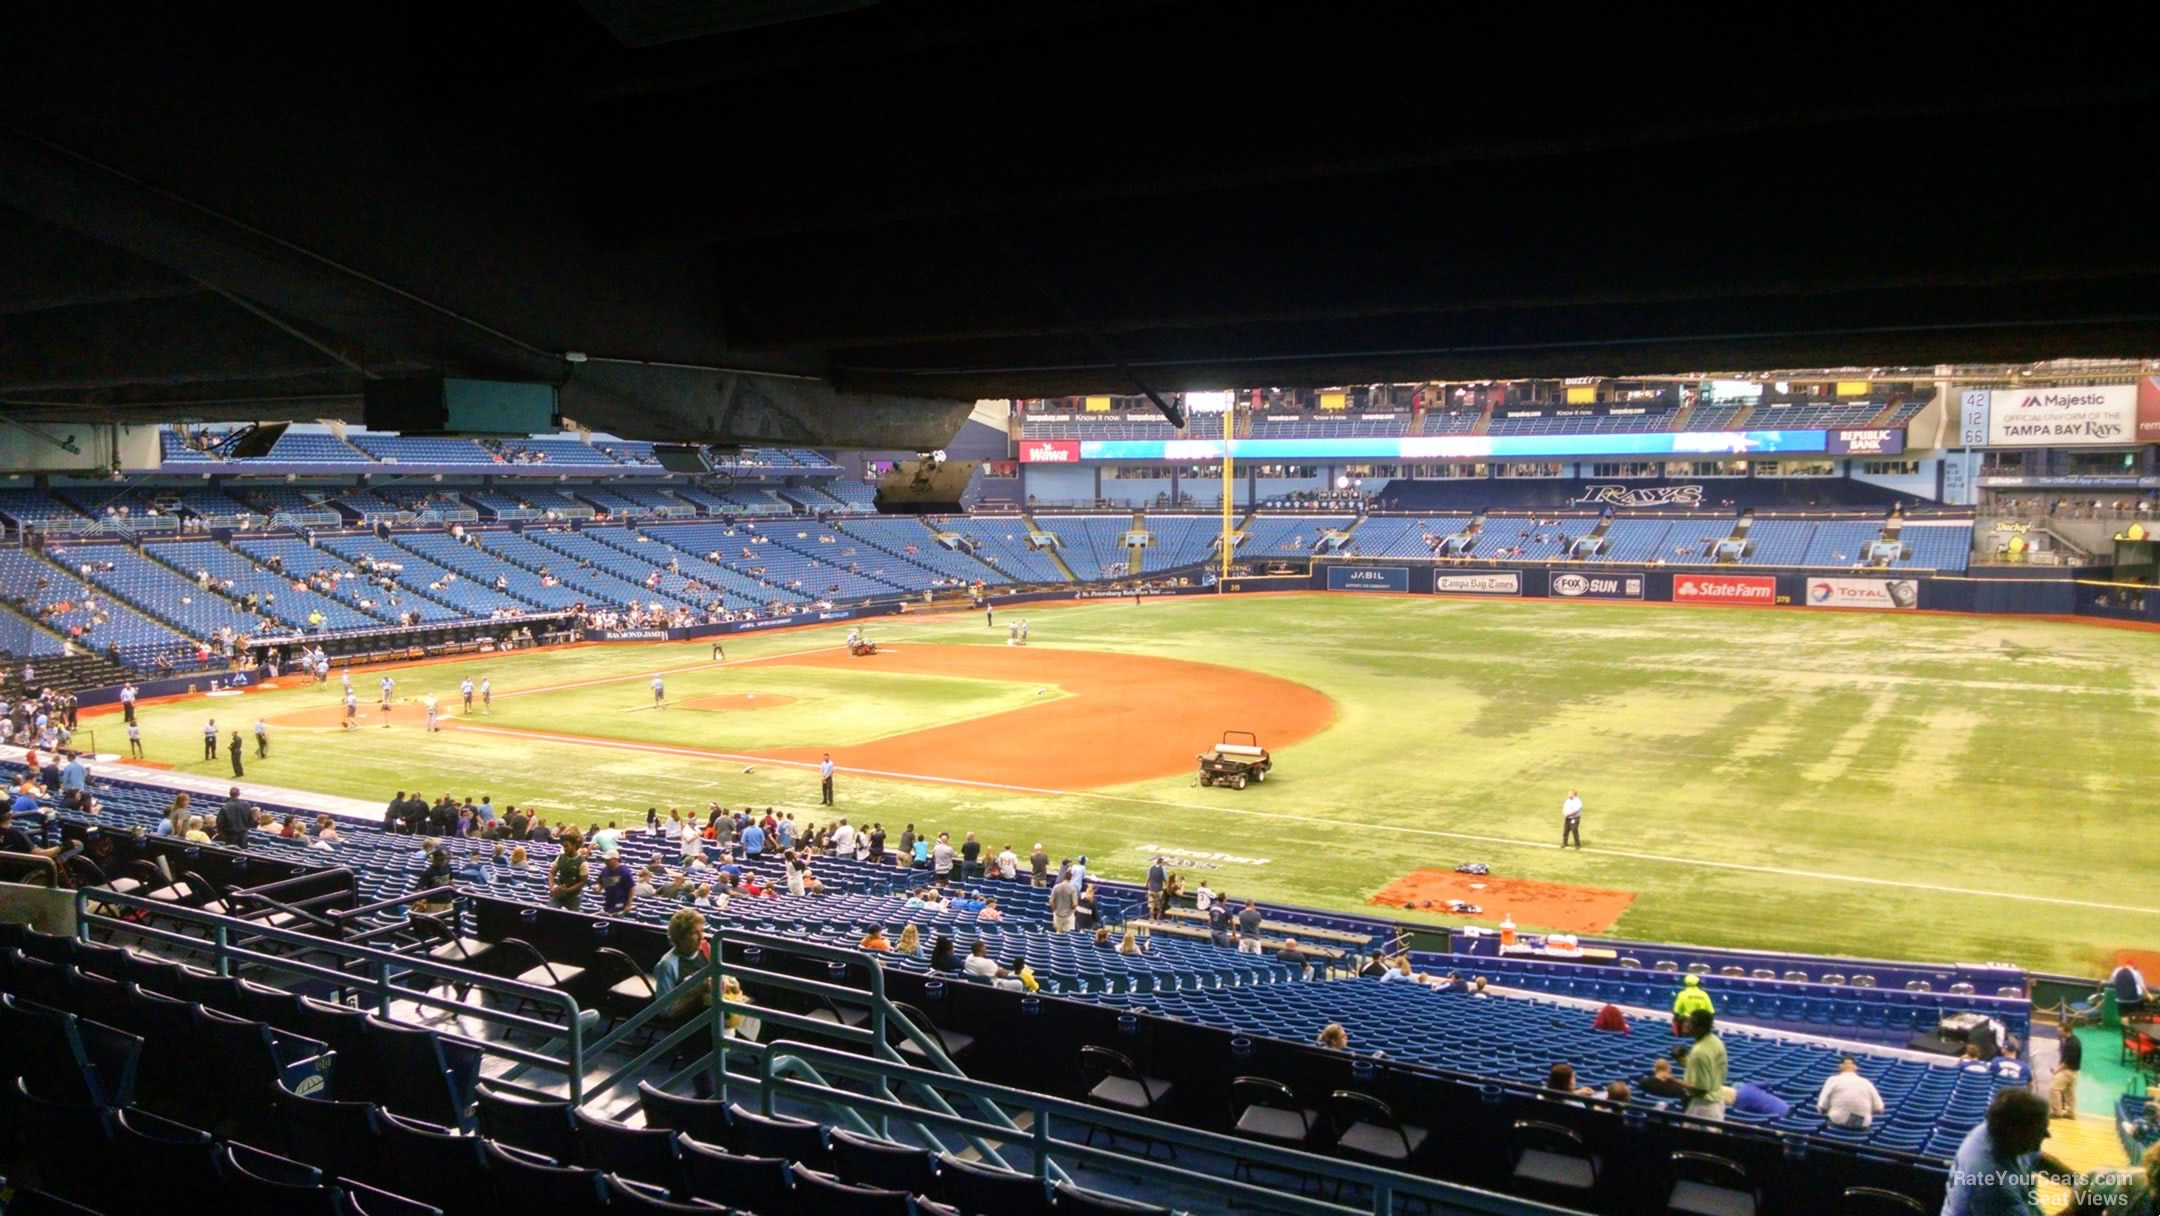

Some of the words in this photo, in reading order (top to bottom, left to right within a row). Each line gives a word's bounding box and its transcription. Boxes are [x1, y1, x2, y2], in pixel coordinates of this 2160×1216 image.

[1966, 393, 1985, 406] 42
[2044, 393, 2105, 409] Majestic
[1075, 414, 1096, 422] Know
[1967, 411, 1982, 425] 12
[2003, 414, 2040, 423] OFFICIAL
[2045, 412, 2087, 422] UNIFORM
[2089, 411, 2100, 421] OF
[2104, 411, 2121, 420] THE
[1840, 430, 1892, 440] REPUBLIC
[2003, 425, 2051, 436] TAMPA
[2054, 424, 2082, 436] BAY
[1965, 430, 1983, 443] 66
[1849, 440, 1881, 449] BANK
[1029, 448, 1068, 461] Wawa
[1350, 571, 1385, 579] JABIL
[1441, 578, 1469, 590] Tampa
[1469, 578, 1488, 590] Bay
[1488, 578, 1514, 589] Times
[1561, 579, 1581, 587] FOX
[1589, 580, 1618, 593] SUN
[1838, 587, 1887, 598] TOTAL
